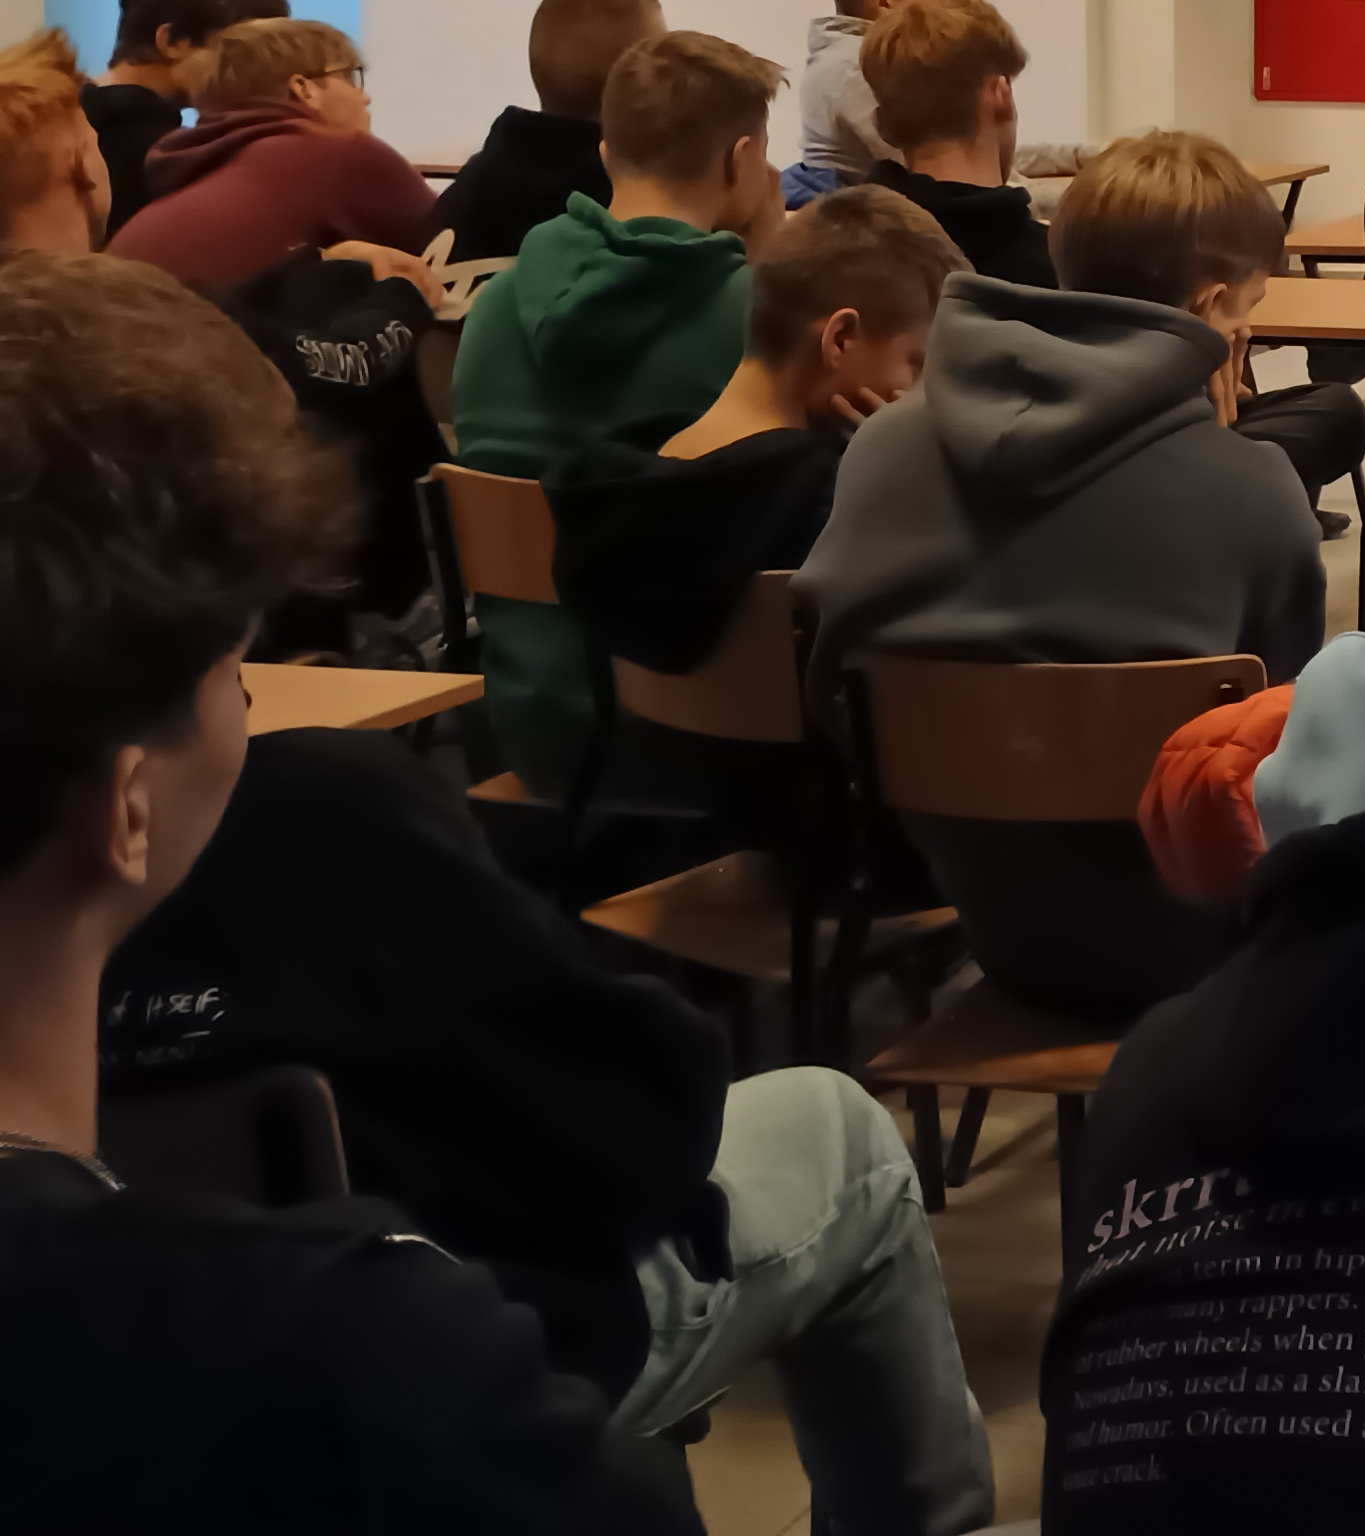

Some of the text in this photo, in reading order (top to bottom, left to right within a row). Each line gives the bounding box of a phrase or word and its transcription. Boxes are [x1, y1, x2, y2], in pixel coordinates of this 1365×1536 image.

[1194, 1253, 1261, 1280] term
[1274, 1250, 1302, 1270] in
[1239, 1292, 1358, 1319] rappers.
[1099, 1337, 1169, 1369] rubber
[1175, 1327, 1262, 1356] wheels
[1274, 1325, 1353, 1352] when
[1184, 1367, 1247, 1396] used
[1256, 1374, 1284, 1392] as
[1293, 1374, 1308, 1392] a
[1097, 1417, 1174, 1445] humor.
[1187, 1408, 1266, 1437] Often
[1279, 1410, 1352, 1438] used
